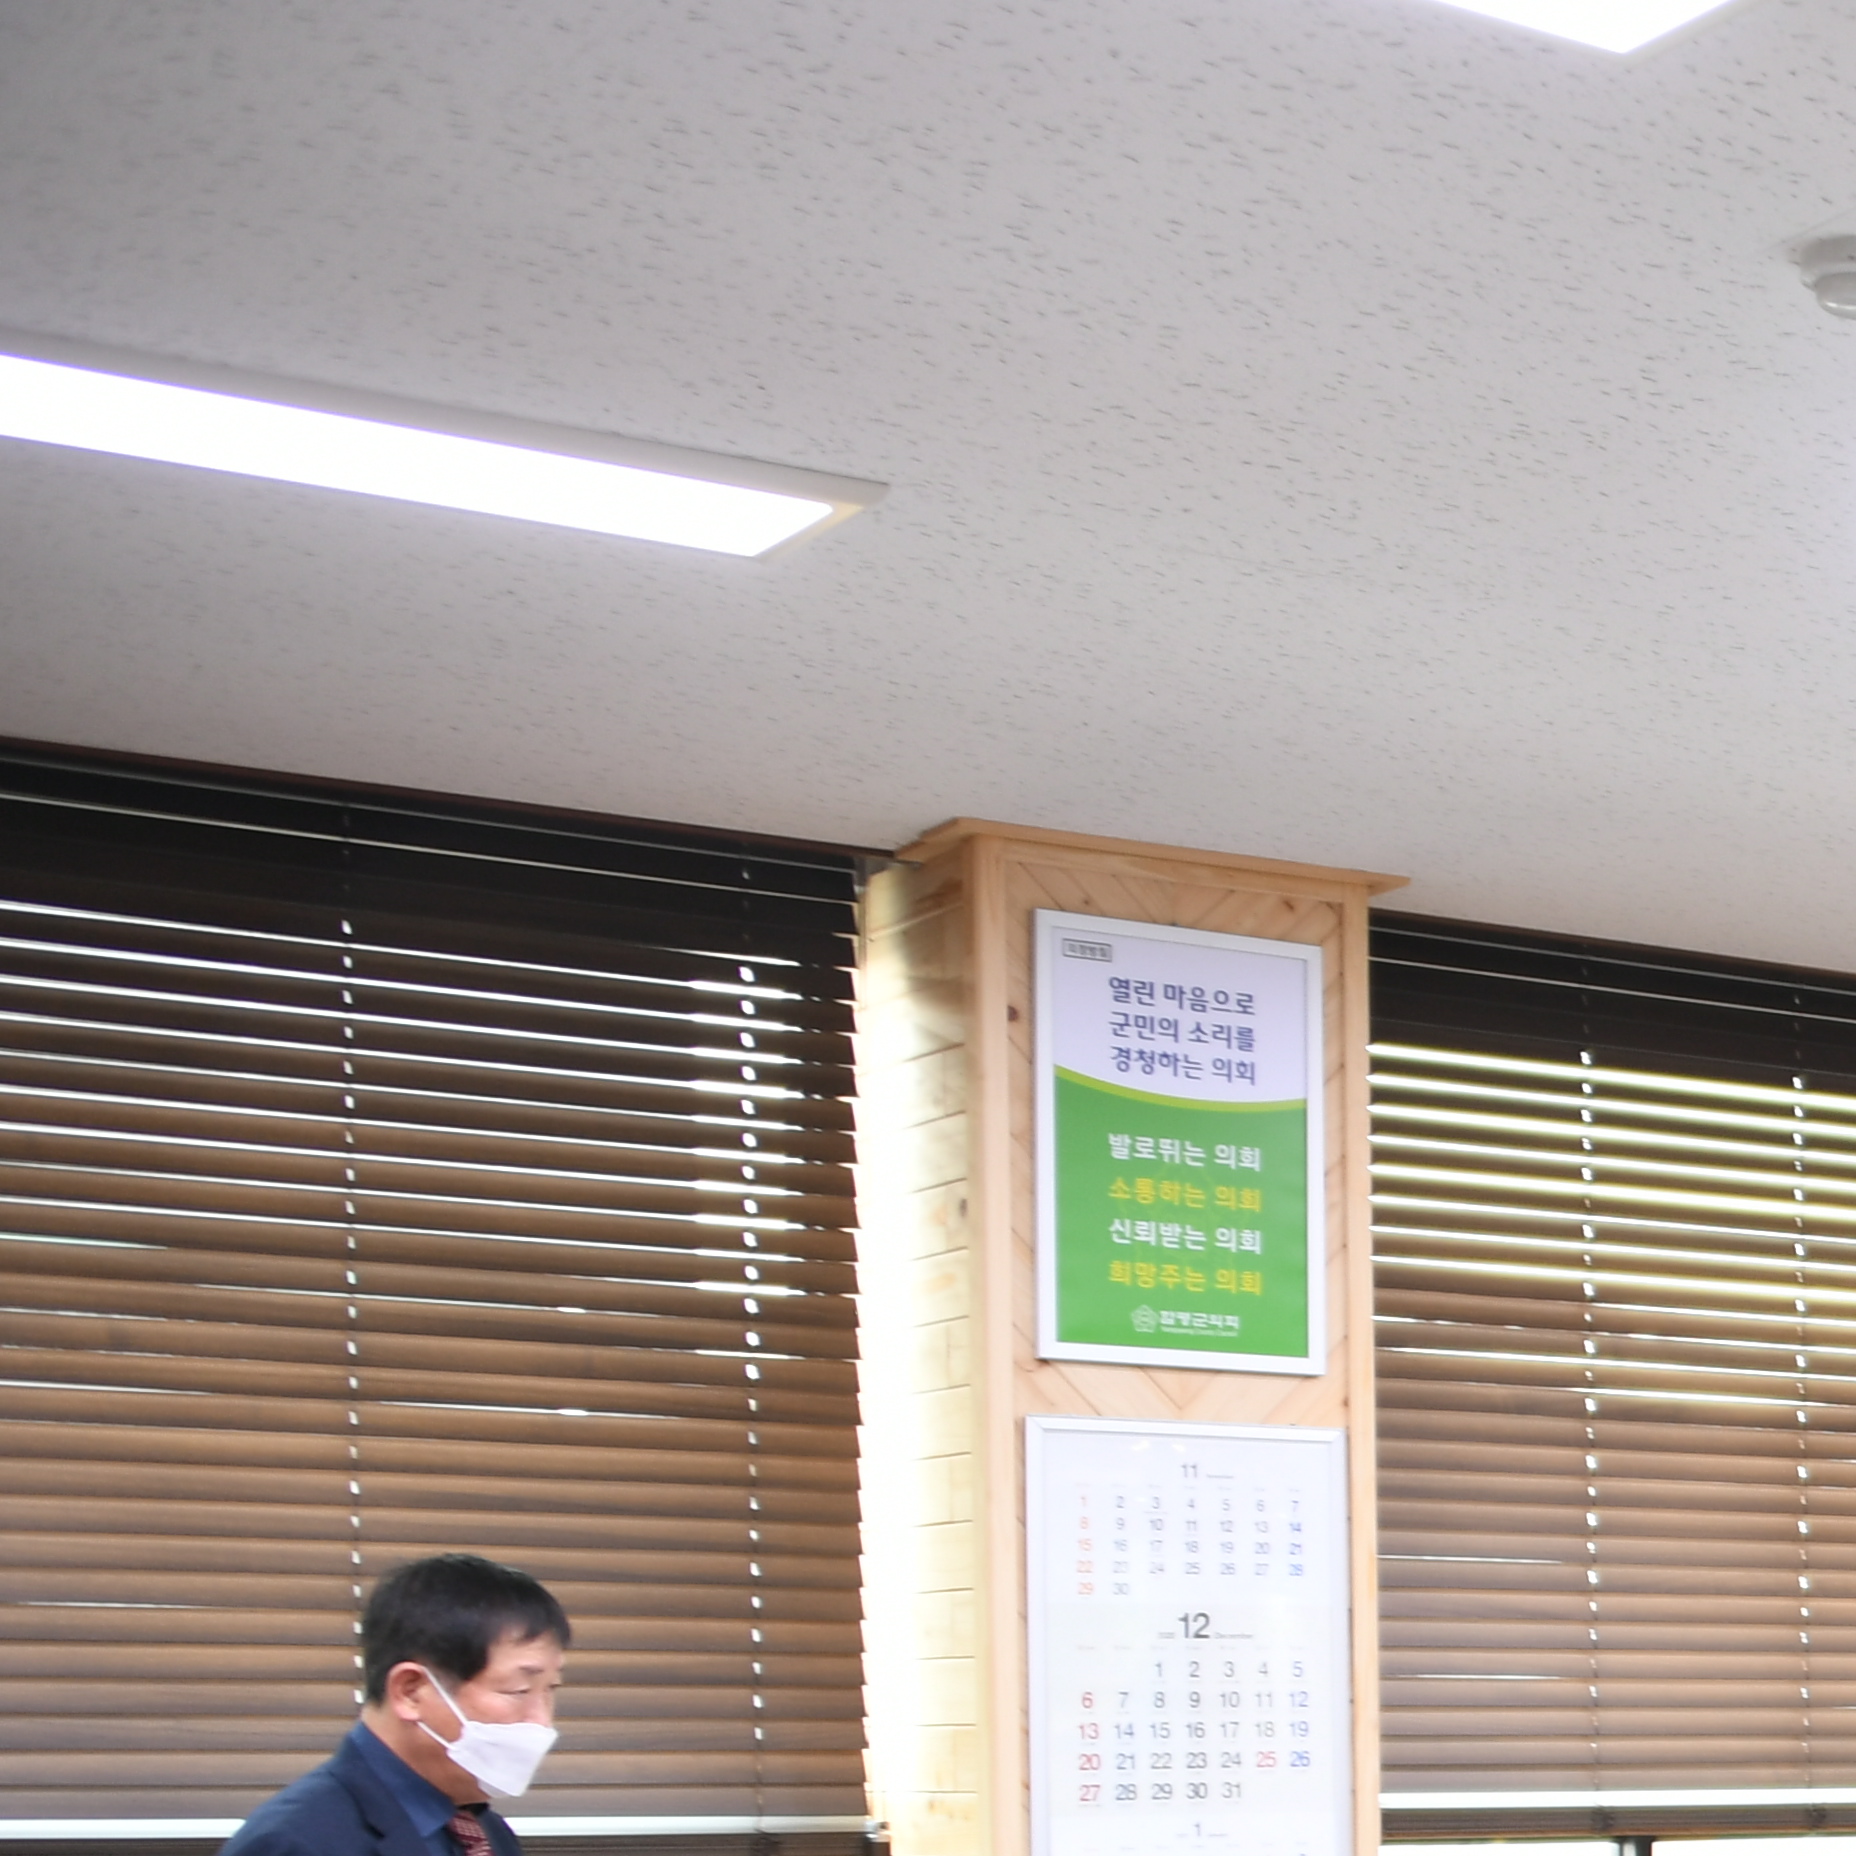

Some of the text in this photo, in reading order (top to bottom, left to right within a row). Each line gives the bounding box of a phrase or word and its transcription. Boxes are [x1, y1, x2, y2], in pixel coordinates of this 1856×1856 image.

[1109, 976, 1255, 1015] 열린 마음으로
[1108, 1011, 1255, 1052] 군민의 소리를
[1110, 1045, 1255, 1086] 경청하는 의회
[1108, 1133, 1261, 1172] 발로뛰는 의회
[1108, 1177, 1261, 1212] 소통하는 의회
[1109, 1218, 1261, 1255] 신뢰받는 의회
[1109, 1260, 1261, 1296] 희망주는 의회
[1180, 1463, 1198, 1478] 11
[1178, 1612, 1211, 1639] 12
[1154, 1661, 1304, 1678] 1 2 3 4 5
[1081, 1691, 1309, 1708] 6 7 8 9 10 11 12
[1078, 1721, 1309, 1740] 13 14 15 16 17 18 19
[1078, 1750, 1311, 1771] 20 21 22 23 24 25 26
[1078, 1782, 1241, 1802] 27 28 29 30 31
[1193, 1822, 1201, 1837] 1
